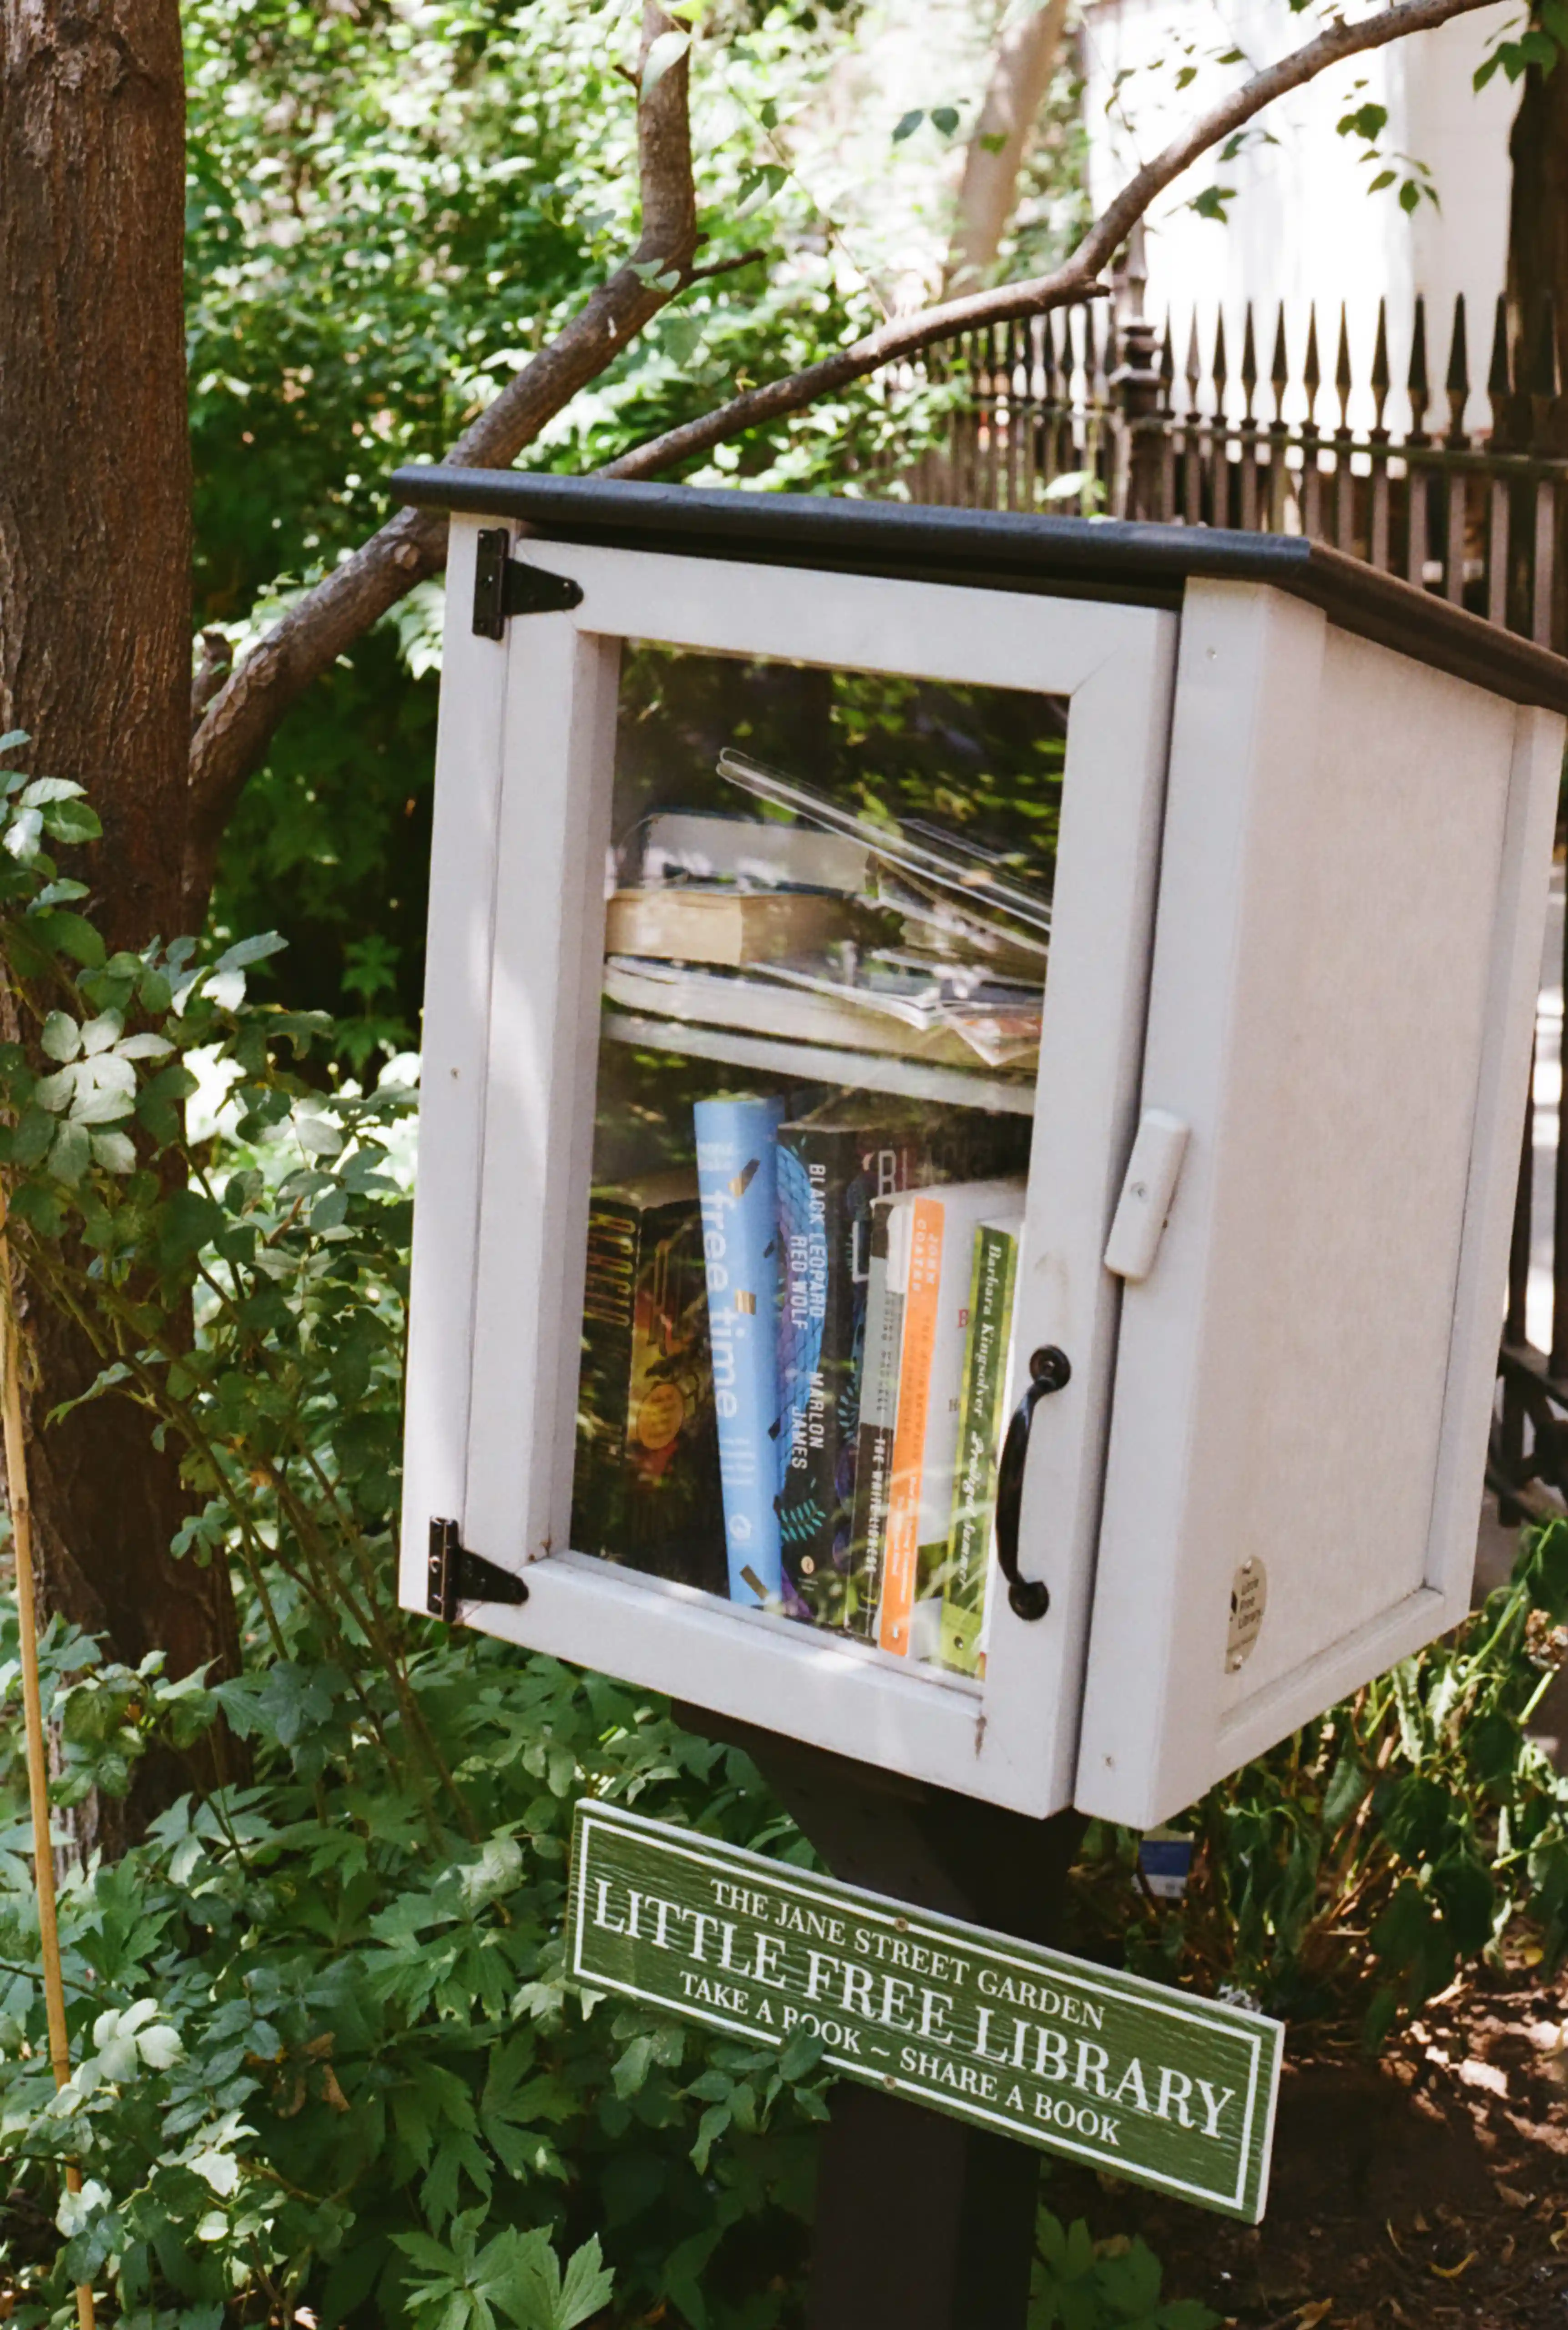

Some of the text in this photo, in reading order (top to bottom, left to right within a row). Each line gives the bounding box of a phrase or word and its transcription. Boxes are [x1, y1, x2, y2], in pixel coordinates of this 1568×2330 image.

[702, 1190, 734, 1291] free
[790, 1235, 809, 1330] RED WOLF
[809, 1164, 826, 1317] BLACK LEOPARD
[983, 1244, 1001, 1315] Barbara
[711, 1306, 746, 1418] time
[809, 1372, 824, 1449] MARLON
[974, 1322, 995, 1418] Kingsolver
[791, 1406, 808, 1470] JAMES
[711, 1879, 1104, 2031] THE JANE STREET GARDEN
[592, 1878, 1235, 2138] LITTLE FREE LIBRARY
[679, 1971, 749, 2014] TAKE
[755, 1999, 774, 2024] A
[782, 2005, 861, 2054] BOOK
[900, 2046, 997, 2101] SHARE
[1005, 2085, 1024, 2111] A
[1034, 2093, 1120, 2145] BOOK
